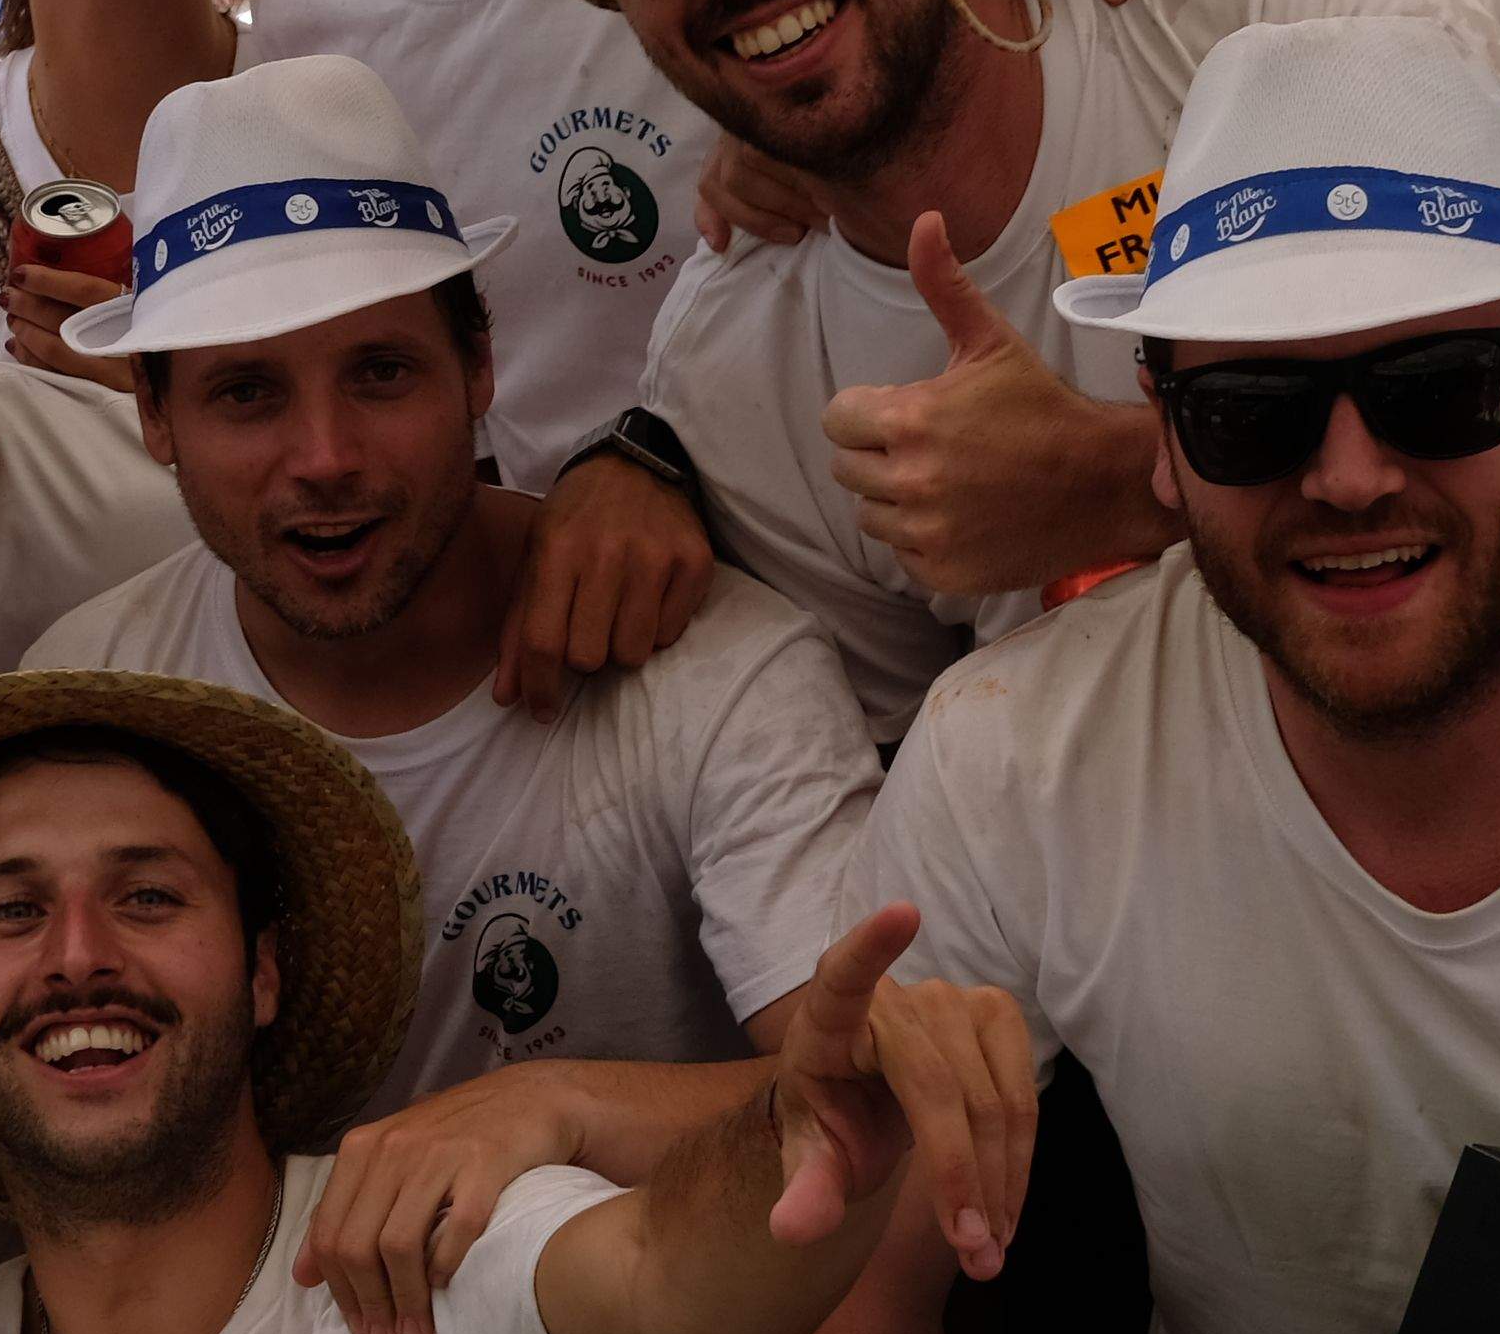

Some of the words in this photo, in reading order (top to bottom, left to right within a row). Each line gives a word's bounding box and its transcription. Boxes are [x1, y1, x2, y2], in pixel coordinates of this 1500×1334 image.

[530, 107, 673, 173] GOURMETS
[190, 208, 244, 251] Blanc
[1216, 196, 1277, 241] Blanc
[1418, 198, 1483, 227] Blanc
[578, 267, 628, 288] SINCE
[638, 254, 676, 283] 1993
[442, 871, 583, 941] GOURMETS
[525, 1026, 566, 1055] 1993
